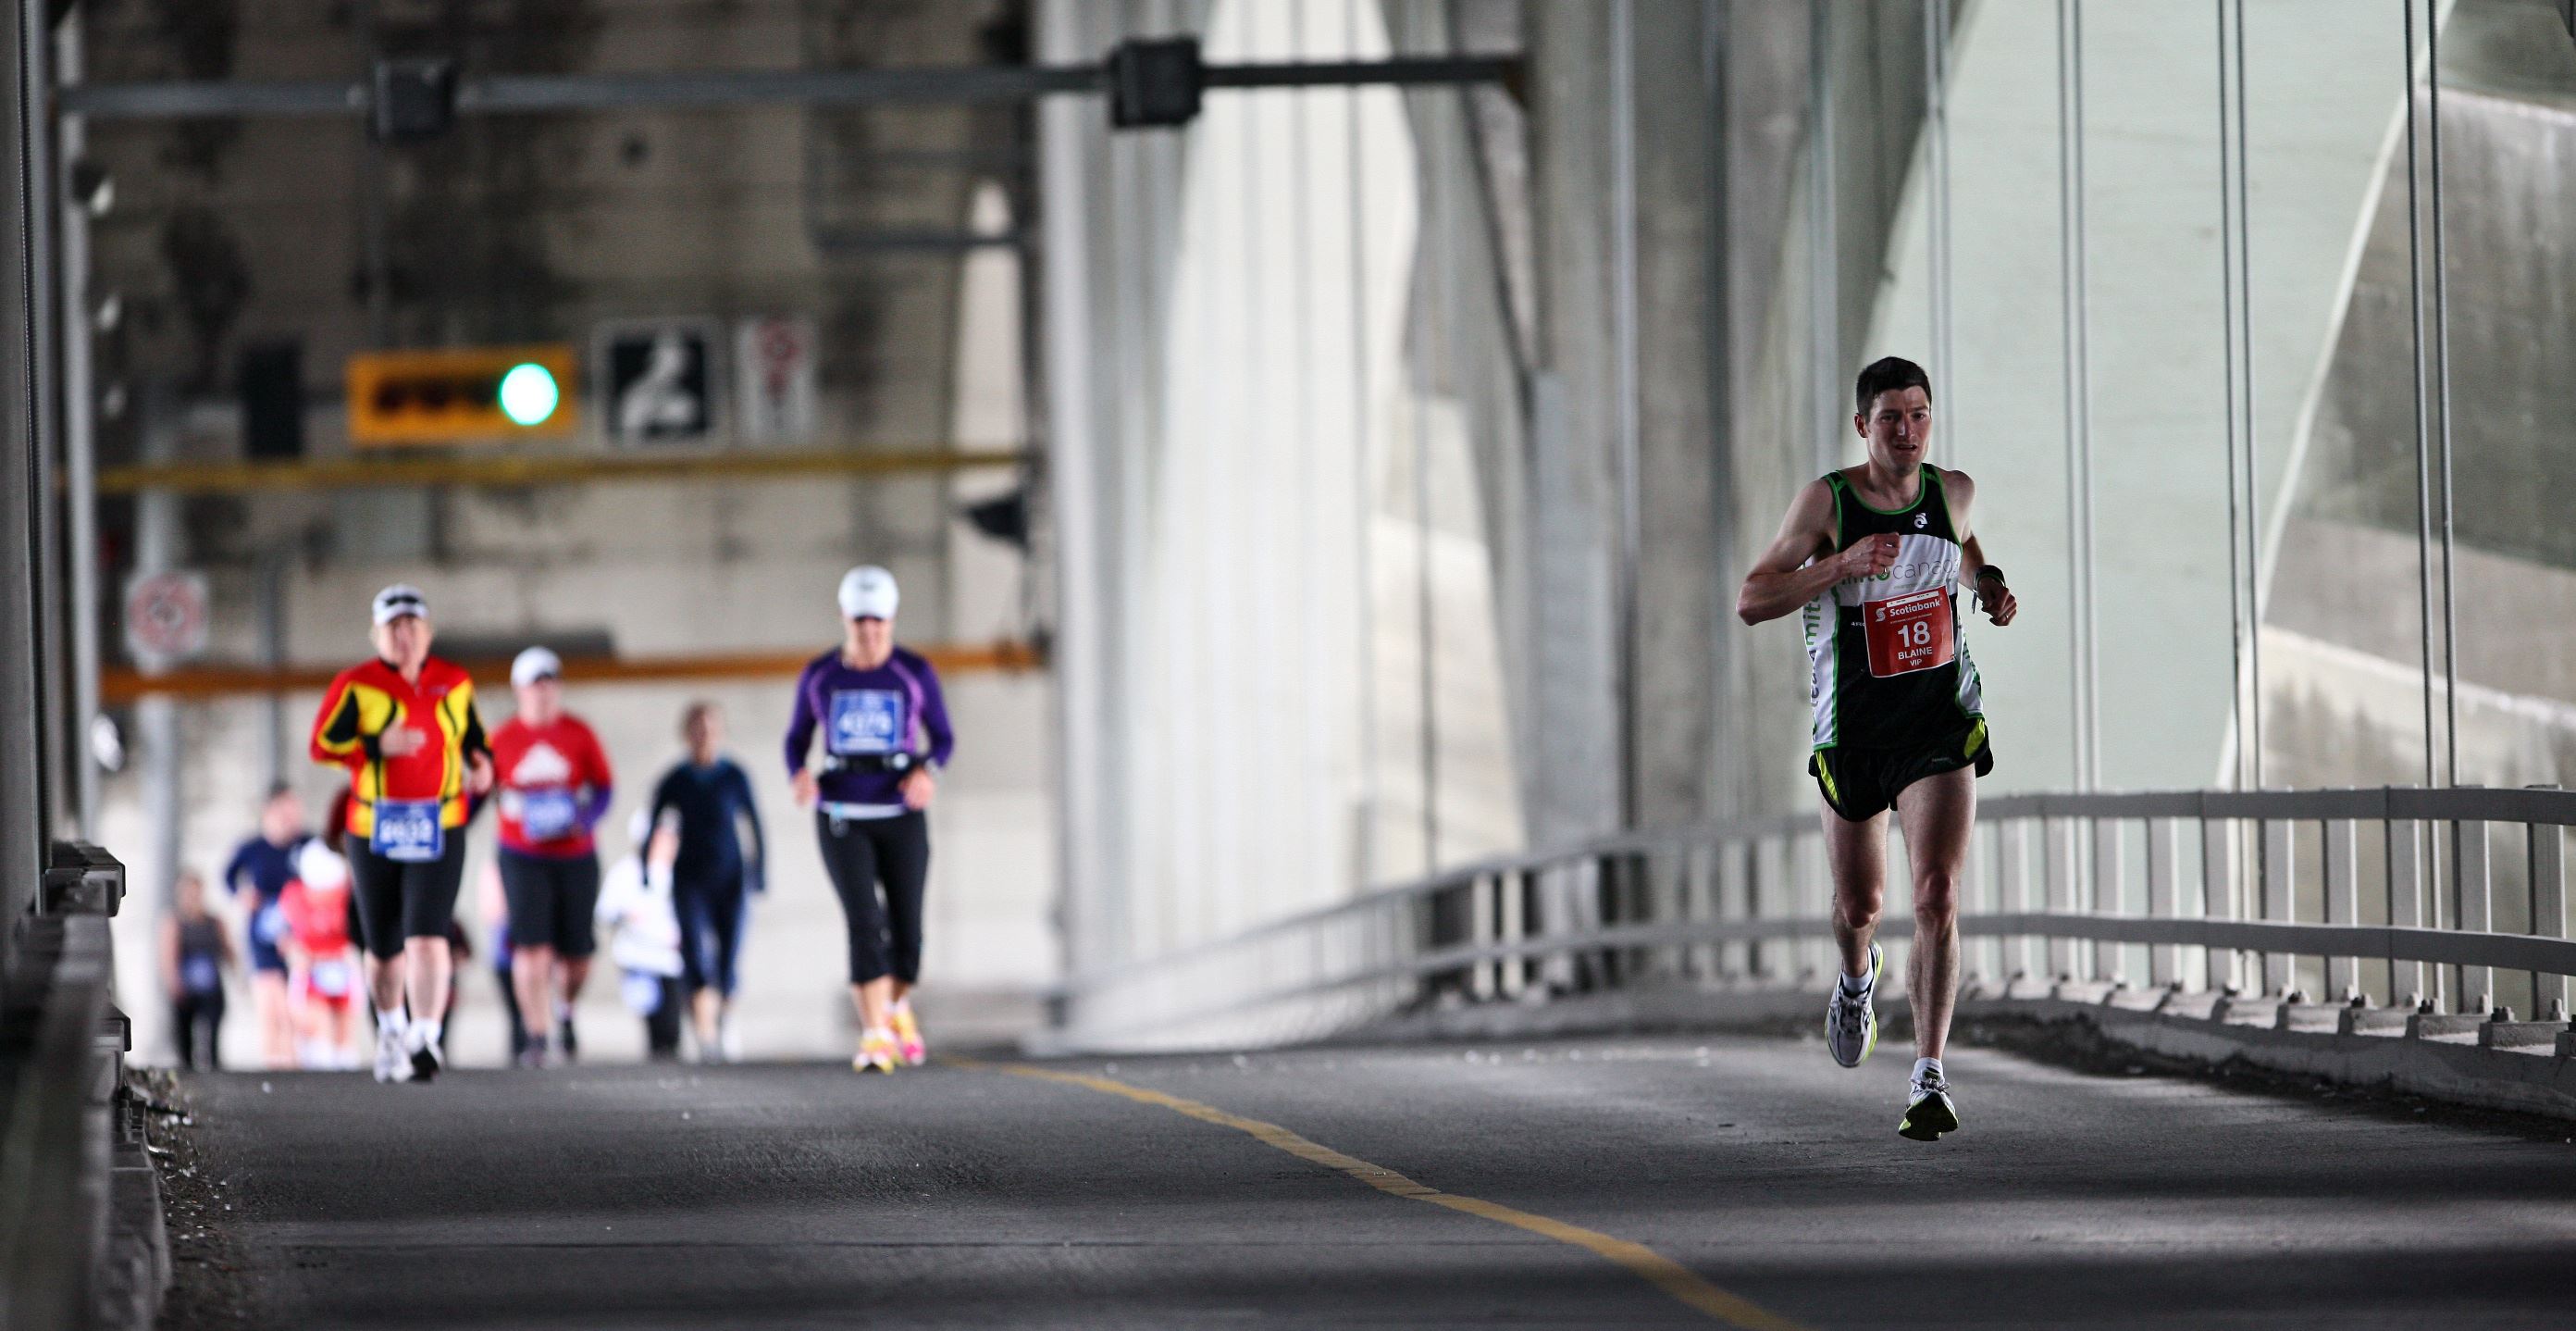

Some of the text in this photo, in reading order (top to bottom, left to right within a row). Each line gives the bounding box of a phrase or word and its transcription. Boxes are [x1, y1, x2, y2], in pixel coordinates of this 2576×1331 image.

[1889, 599, 1940, 616] Scotiabank
[1898, 621, 1930, 648] 18
[1898, 646, 1933, 660] BLAINE
[1910, 658, 1922, 666] VIP
